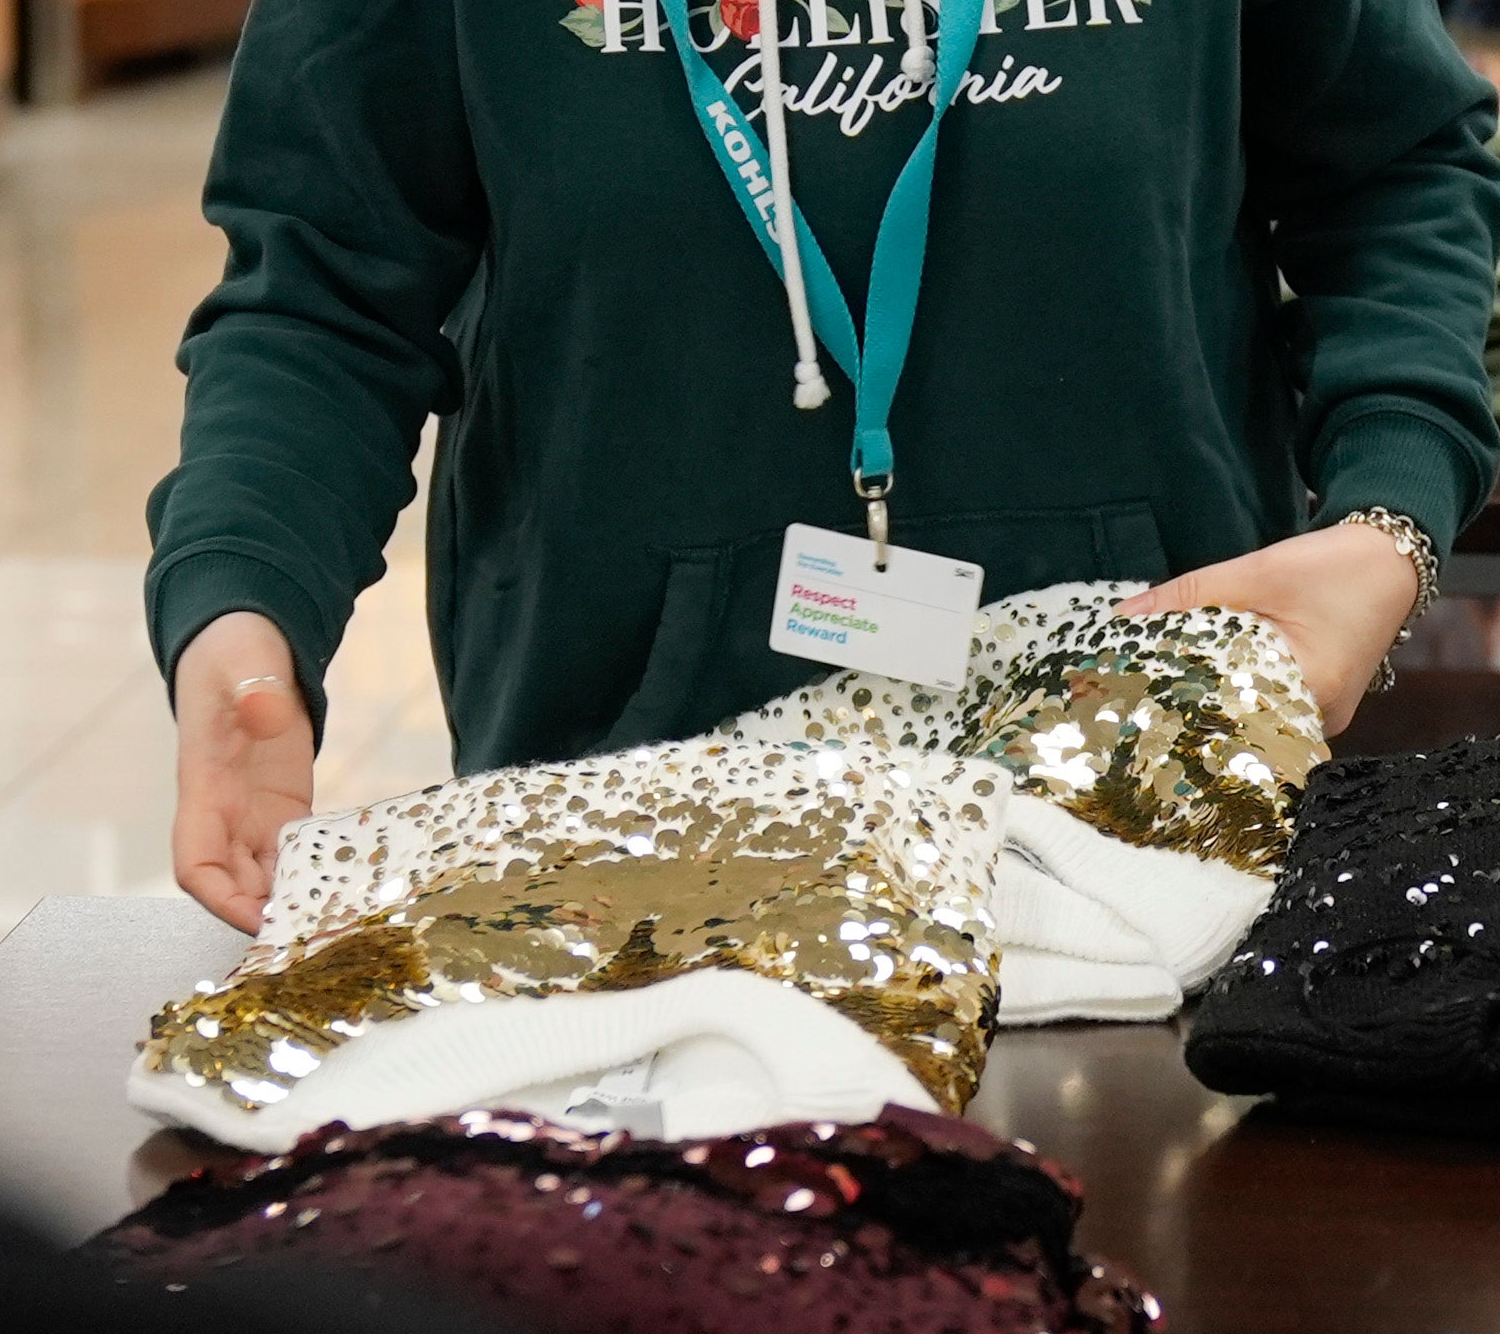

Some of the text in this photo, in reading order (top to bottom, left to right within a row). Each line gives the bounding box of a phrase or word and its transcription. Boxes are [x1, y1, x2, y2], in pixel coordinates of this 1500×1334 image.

[791, 583, 857, 611] Respect
[786, 618, 848, 644] Reward
[789, 602, 879, 634] Appreciate
